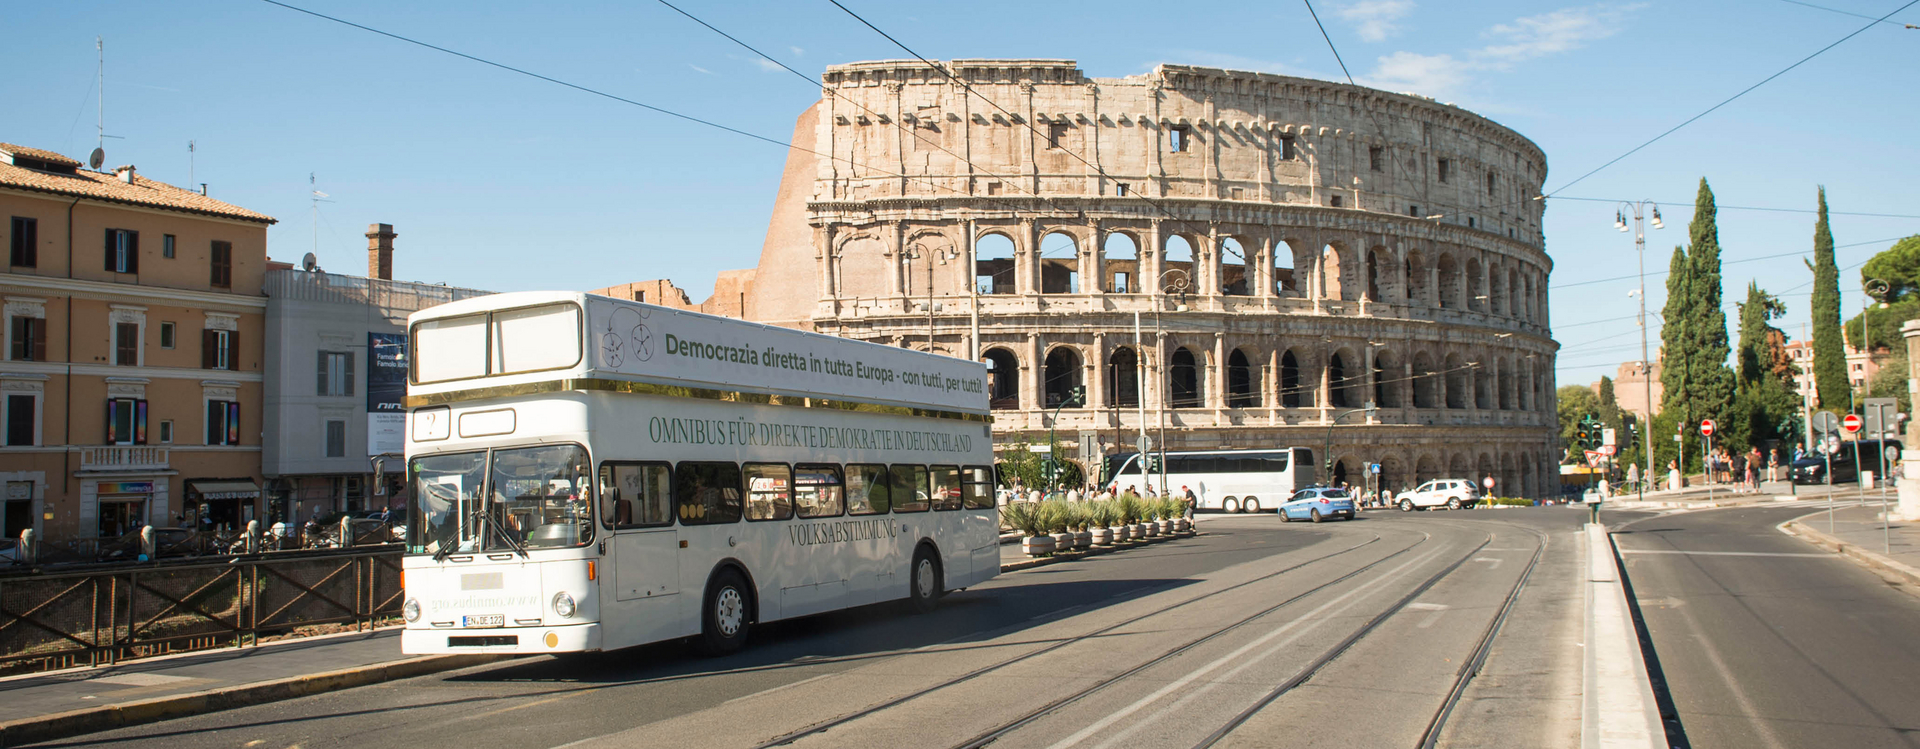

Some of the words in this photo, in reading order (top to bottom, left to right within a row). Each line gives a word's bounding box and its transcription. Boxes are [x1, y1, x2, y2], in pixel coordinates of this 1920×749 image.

[665, 333, 758, 366] Democrazia
[762, 347, 807, 371] diretta
[810, 352, 822, 373] in
[824, 357, 854, 377] tutta
[856, 361, 894, 386] Europa
[902, 371, 920, 385] con
[921, 372, 944, 391] tutti,
[946, 377, 960, 393] per
[961, 378, 983, 394] tutti!
[426, 412, 436, 435] ?
[649, 416, 726, 445] OMNIBUS
[728, 416, 758, 446] FÜR
[760, 423, 818, 448] DIREKTE
[819, 426, 893, 450] DEMOKRATIE
[894, 430, 905, 450] IN
[905, 431, 972, 453] DEUTSCHLAND
[788, 518, 897, 547] VOLKSABSTIMMUNG
[490, 615, 503, 624] 122
